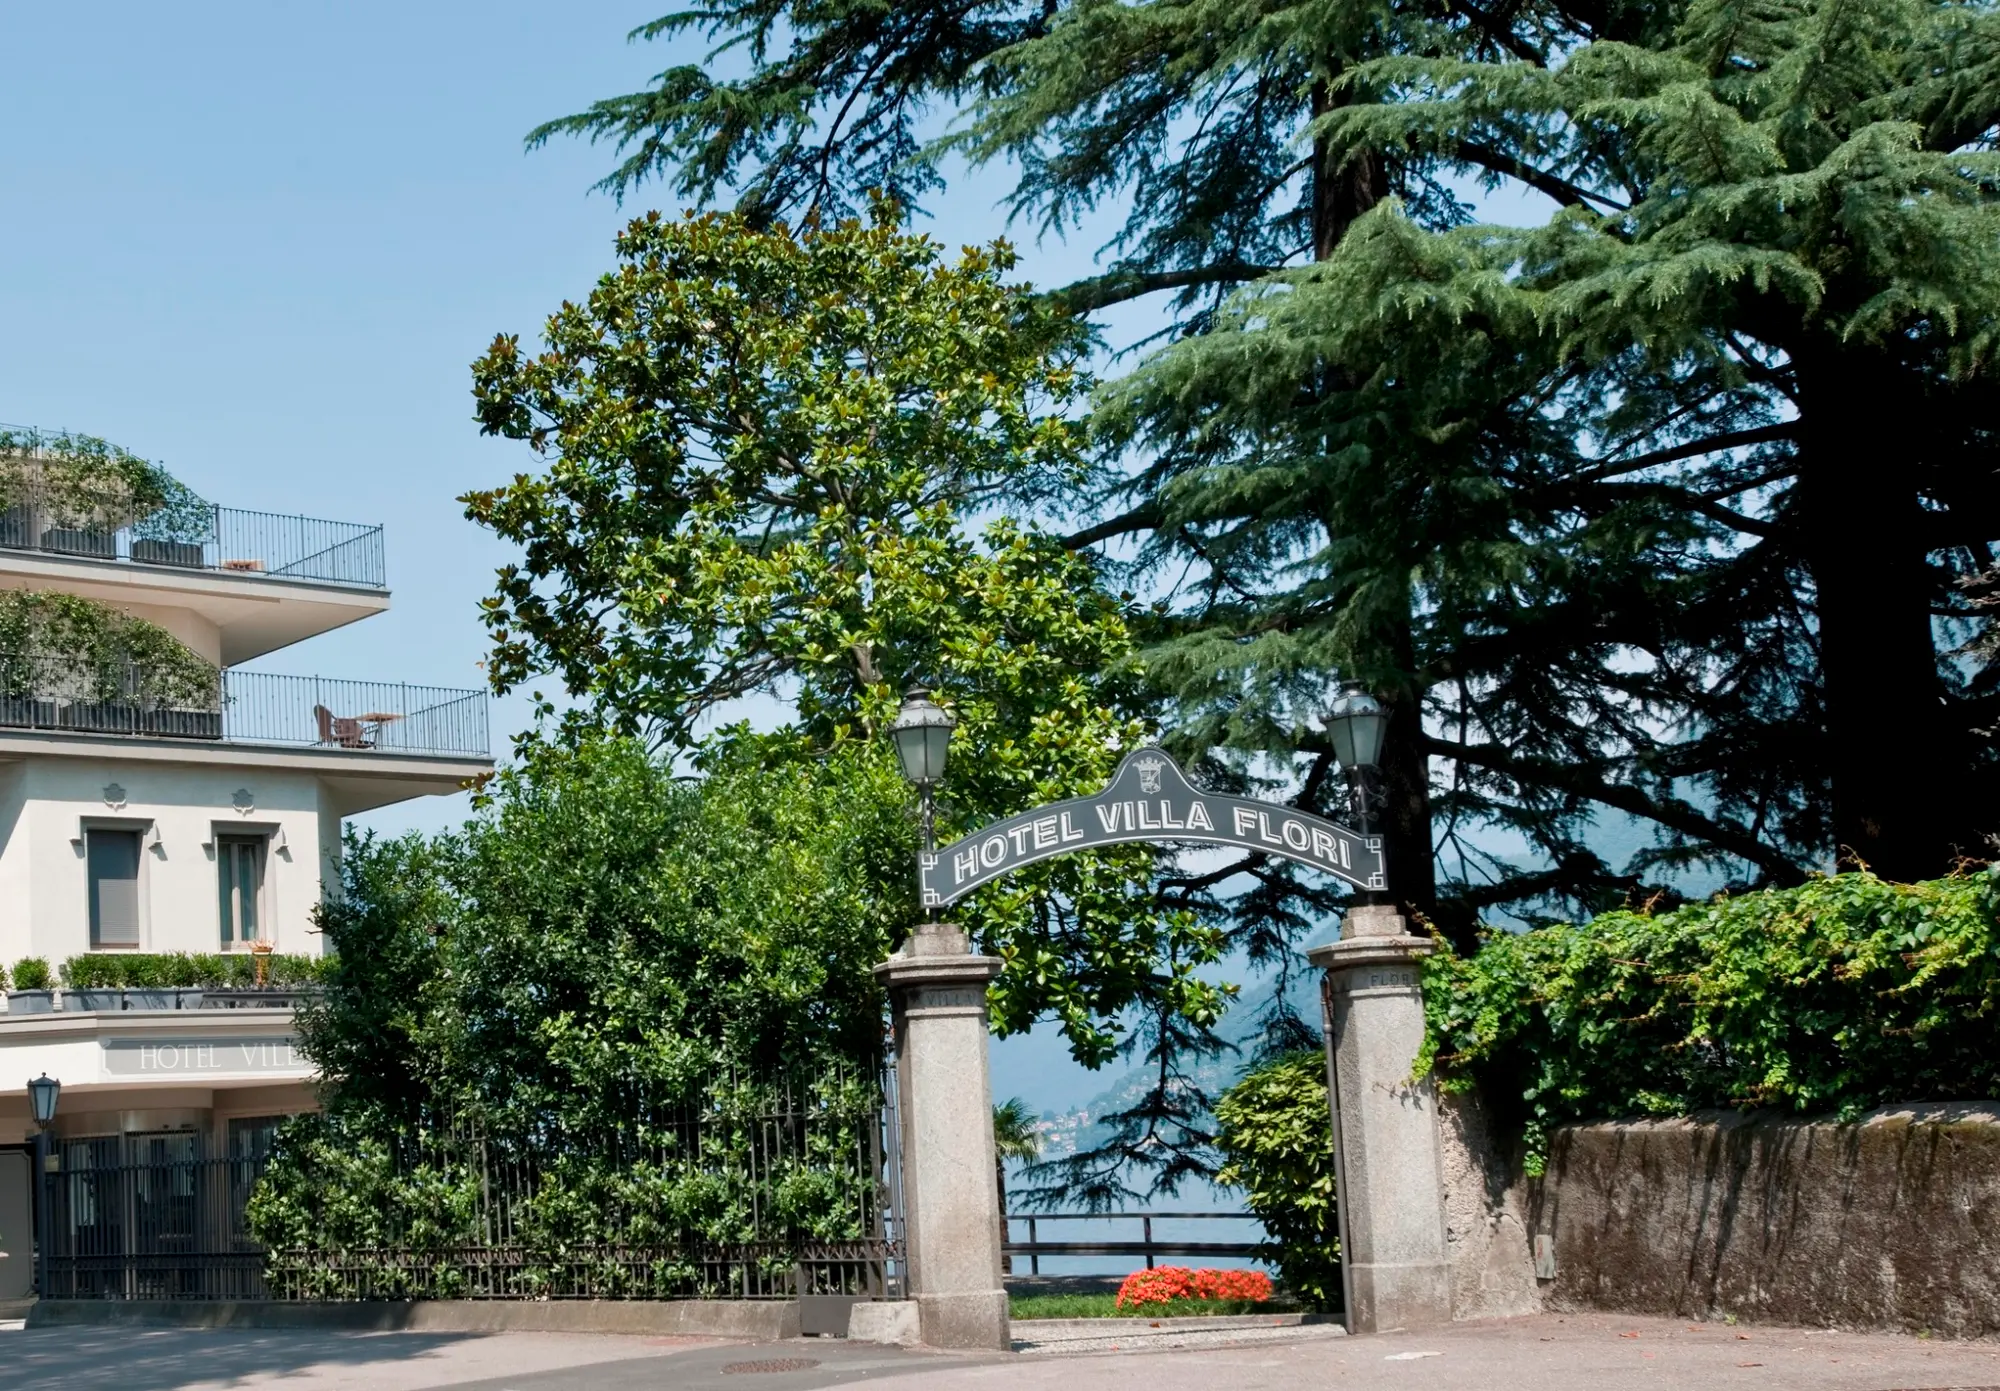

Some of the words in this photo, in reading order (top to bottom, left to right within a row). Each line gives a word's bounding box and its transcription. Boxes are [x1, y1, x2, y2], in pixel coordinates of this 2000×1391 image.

[954, 811, 1084, 885] HOTEL
[1096, 799, 1215, 834] VILLA
[1233, 806, 1352, 871] FLORI
[140, 1044, 222, 1070] HOTEL
